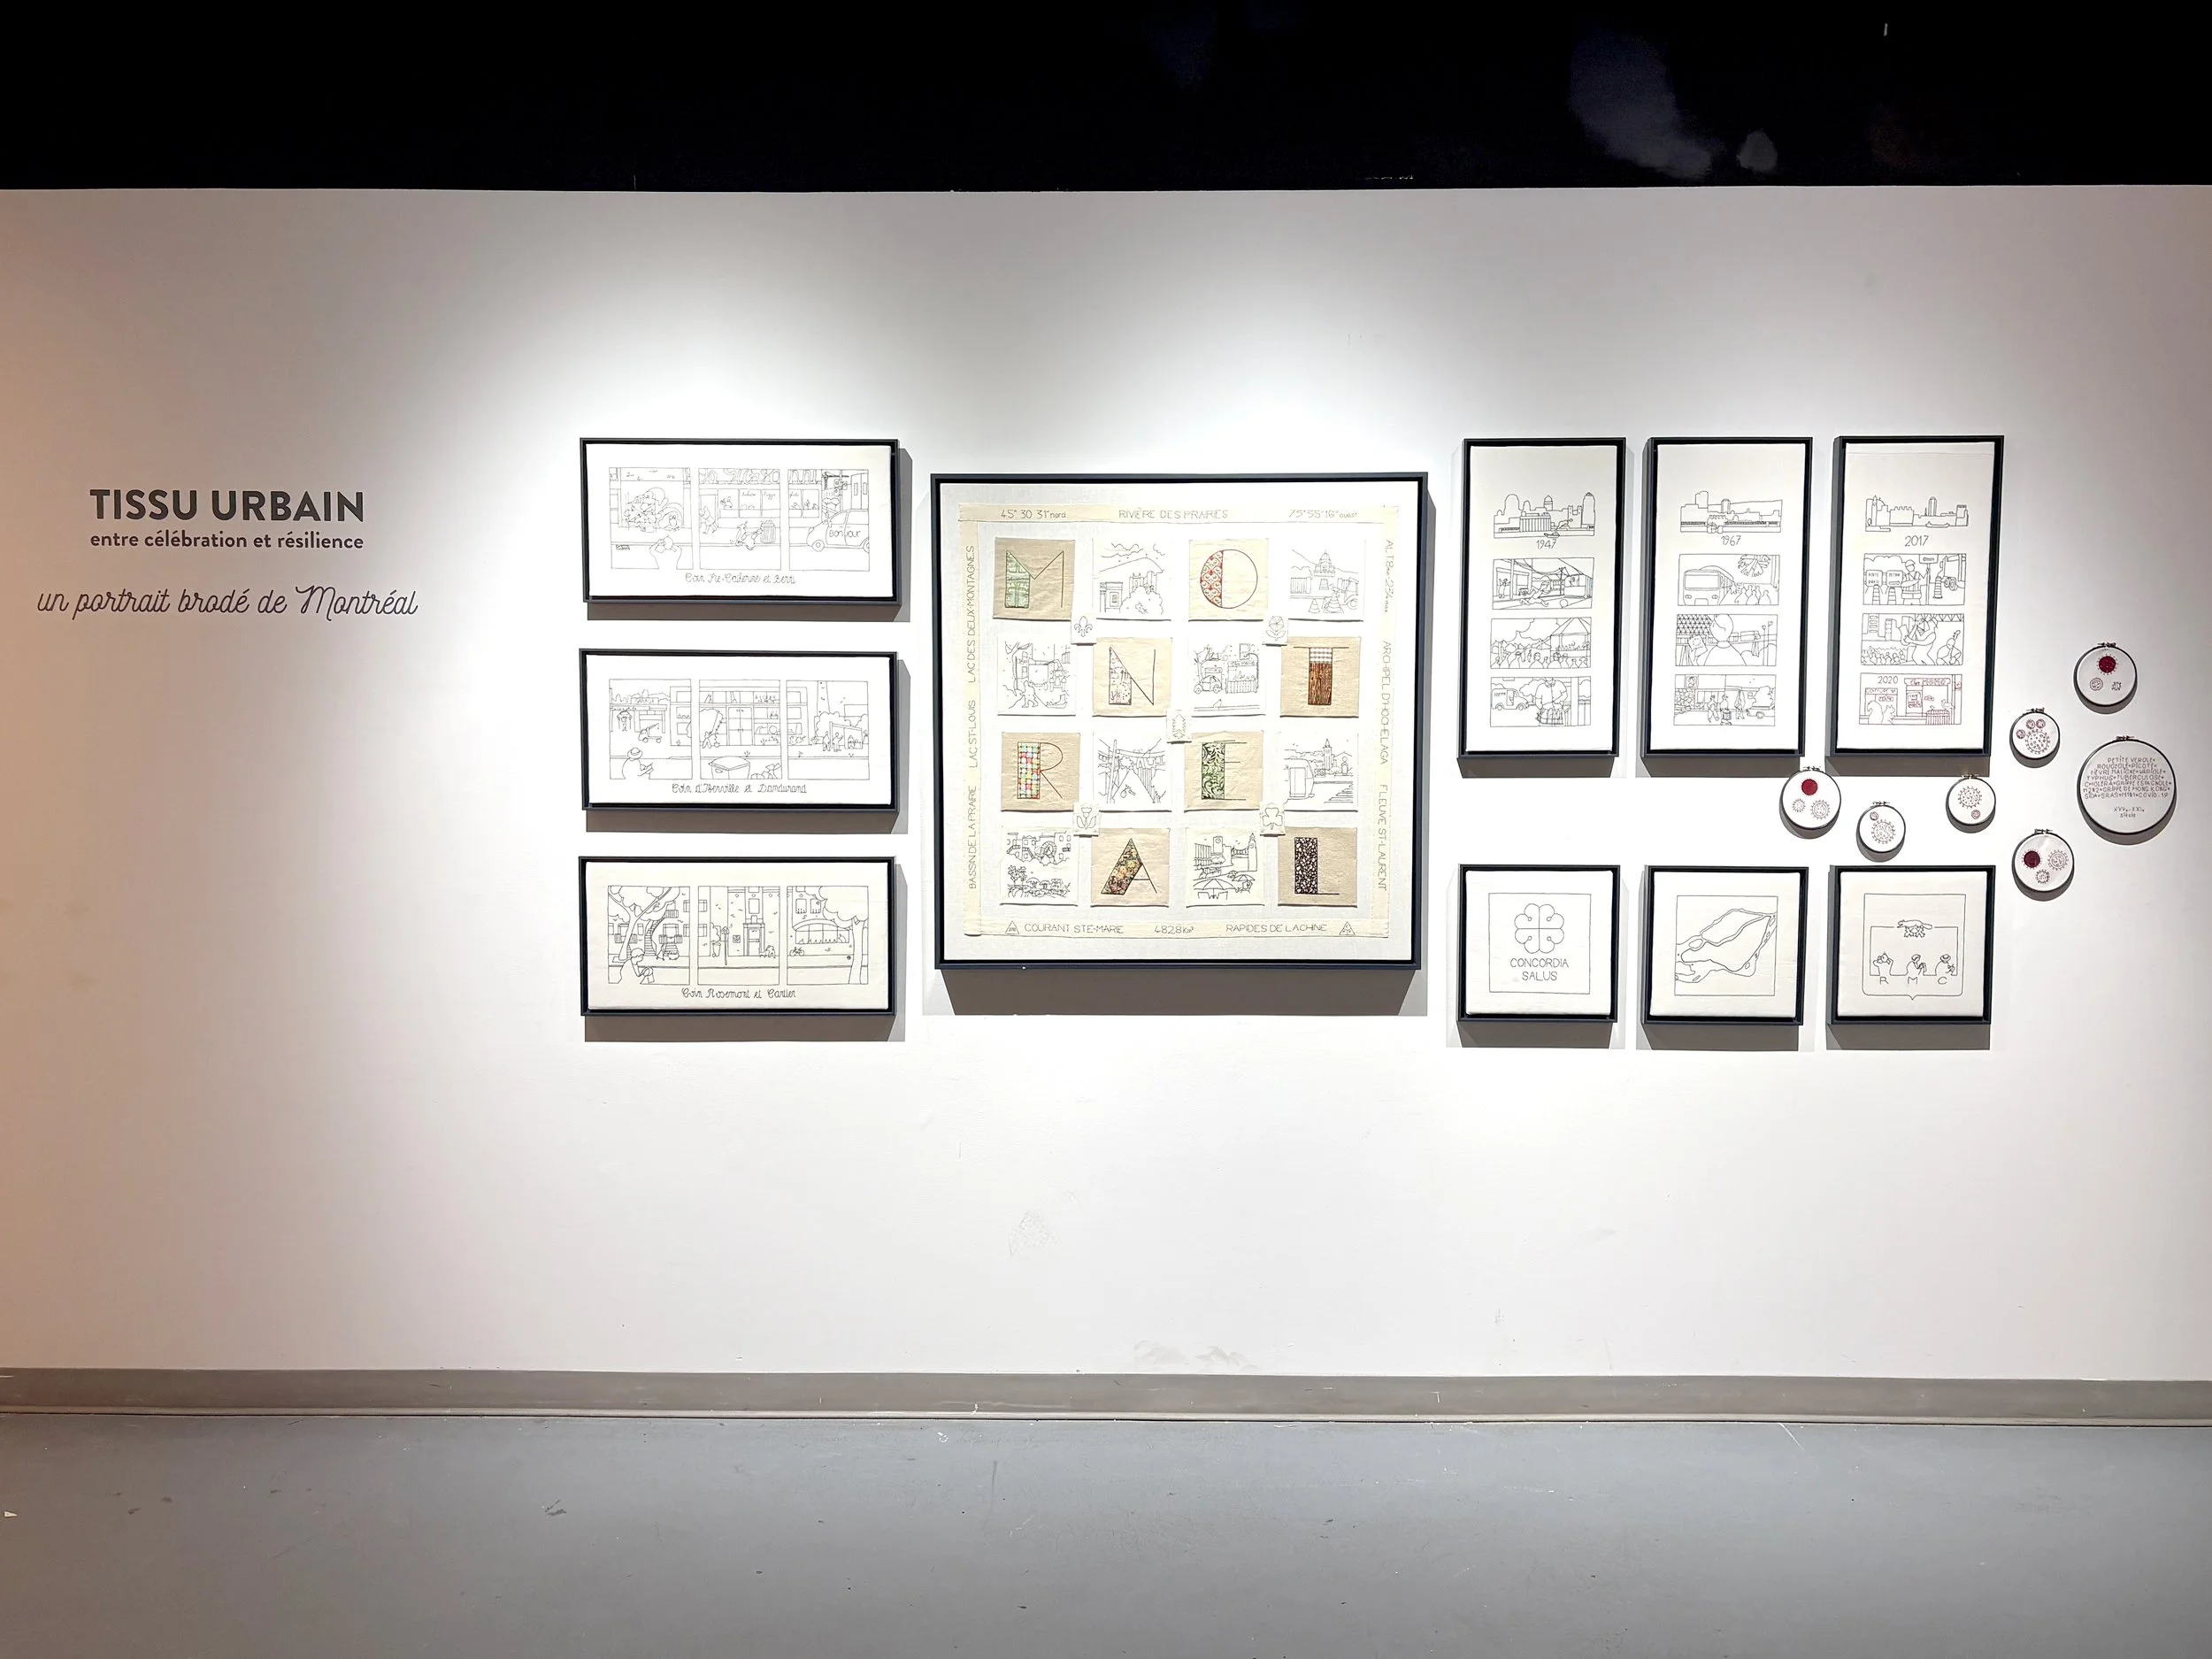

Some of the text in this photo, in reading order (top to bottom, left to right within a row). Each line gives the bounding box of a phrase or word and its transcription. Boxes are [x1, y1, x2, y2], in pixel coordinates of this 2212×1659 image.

[89, 488, 365, 522] TISSU URBAIN
[1159, 510, 1181, 519] DES
[90, 530, 365, 549] entre célébration et résilience
[1536, 538, 1557, 549] 1947
[1720, 534, 1741, 546] 1967
[1904, 534, 1929, 547] 2017
[1006, 549, 1258, 609] M O
[37, 585, 419, 621] un portrait brodé de Montréal
[966, 640, 975, 661] DES
[966, 662, 976, 683] LAC
[1878, 675, 1898, 684] 2020
[968, 747, 978, 768] LAC
[1017, 741, 1064, 799] R
[968, 822, 976, 837] LA
[1377, 784, 1387, 892] FLEUVE ST-LAURENT
[968, 840, 977, 854] DE
[1024, 924, 1070, 933] COURANT
[1225, 924, 1267, 933] RAPIDES
[1270, 924, 1284, 933] DE
[1509, 957, 1569, 968] CONCORDIA
[1522, 971, 1558, 981] SALUS
[1937, 976, 1947, 985] C
